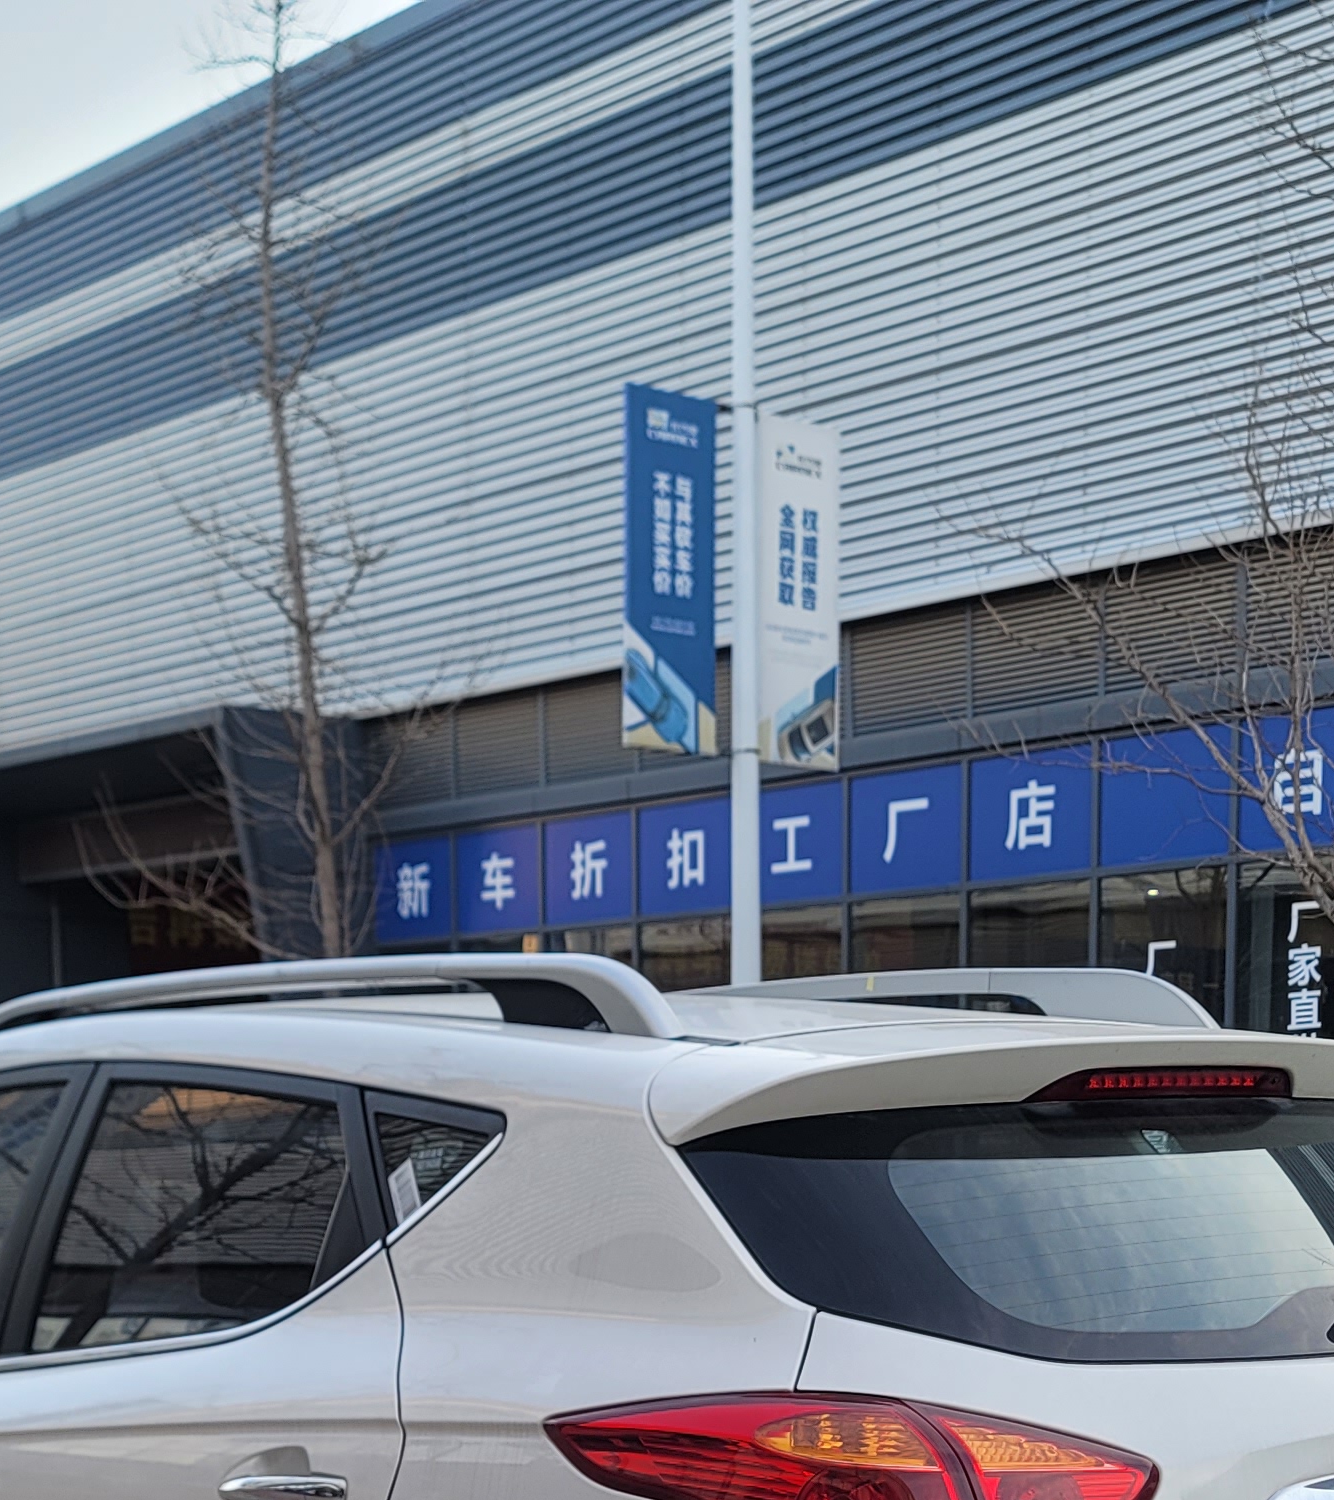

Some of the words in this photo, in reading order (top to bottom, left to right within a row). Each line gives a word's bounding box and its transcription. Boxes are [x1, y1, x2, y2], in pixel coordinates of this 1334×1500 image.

[396, 779, 1057, 919] 新车折扣工厂店
[1286, 900, 1323, 1038] 厂家直
